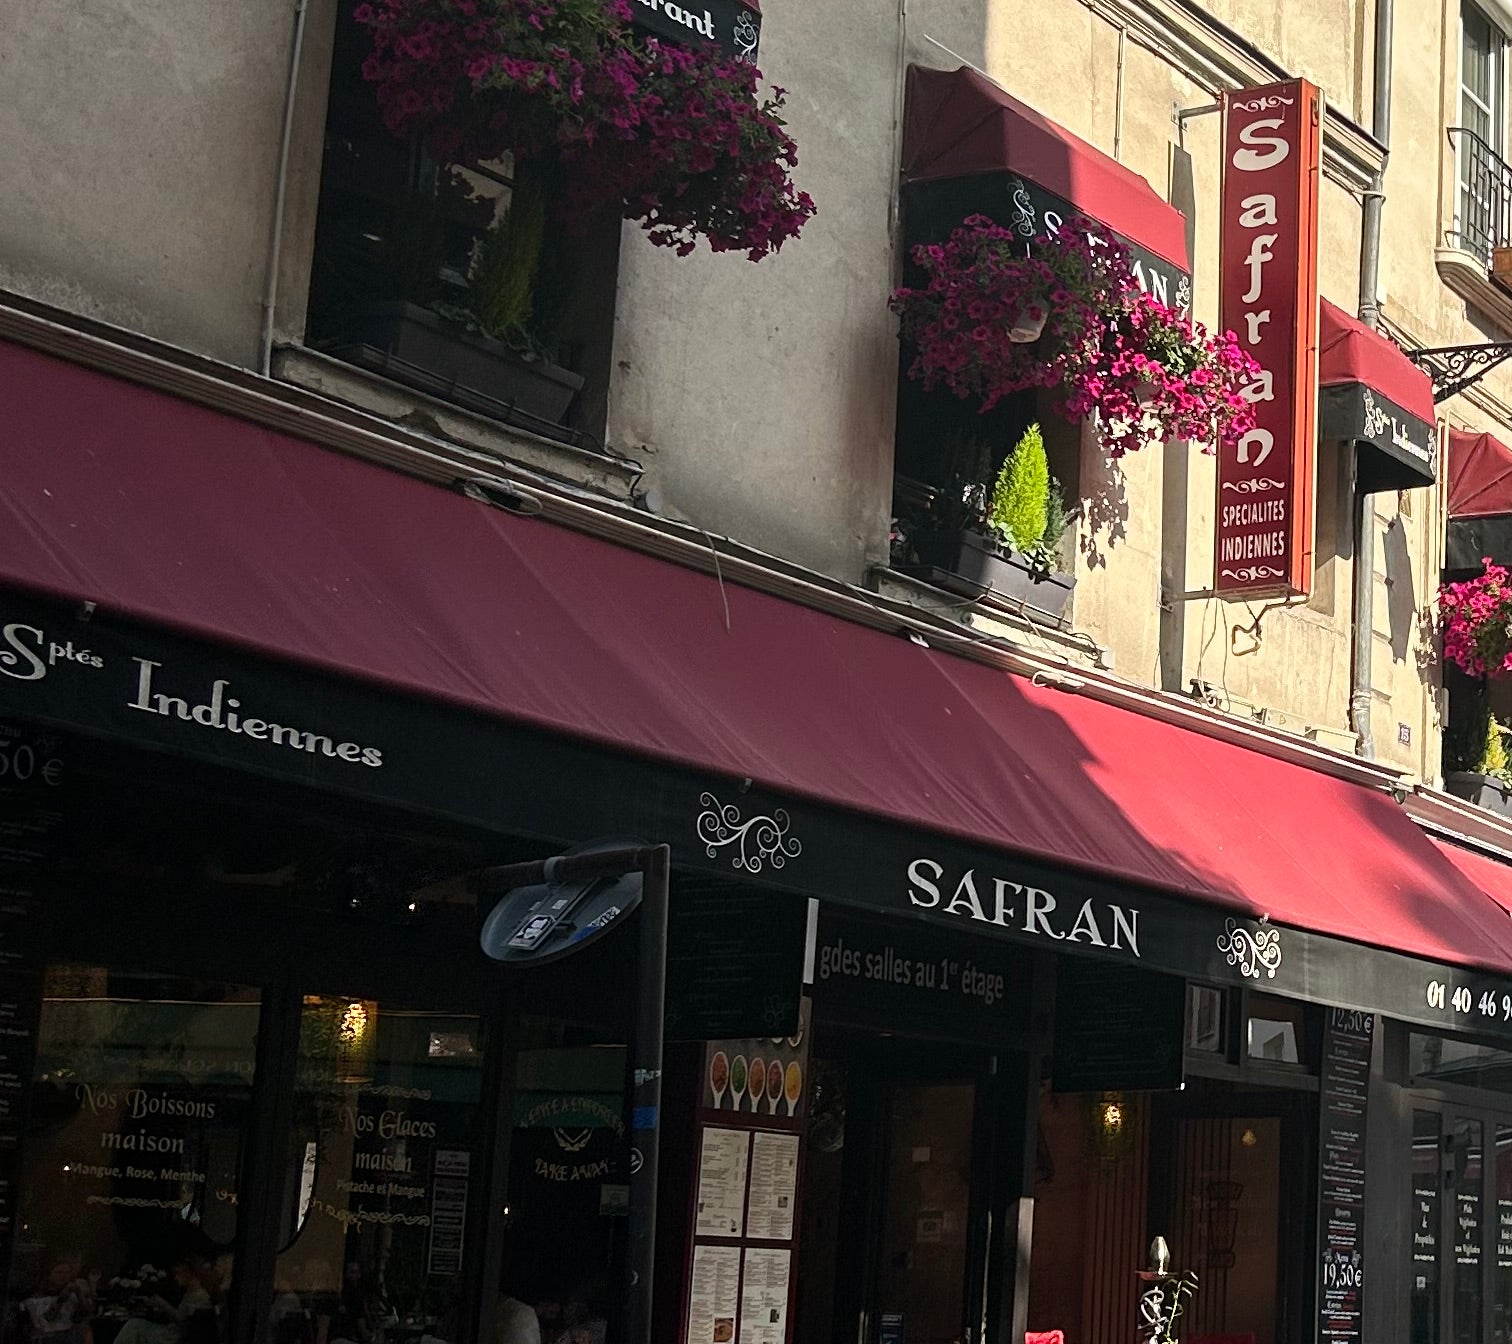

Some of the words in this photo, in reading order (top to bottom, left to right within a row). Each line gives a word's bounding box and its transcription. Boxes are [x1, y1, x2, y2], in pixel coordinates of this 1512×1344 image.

[1232, 118, 1290, 467] Safran
[1222, 498, 1286, 529] SPECIALITES
[1220, 529, 1286, 562] INDIENNES
[128, 656, 383, 768] Indiennes
[906, 858, 1142, 958] SAFRAN
[820, 938, 861, 980] gdes
[864, 946, 912, 985] salles
[915, 961, 936, 988] au
[961, 960, 1004, 1005] étage
[1427, 979, 1445, 1010] 01
[1450, 987, 1472, 1014] 40
[1478, 991, 1497, 1018] 46
[75, 1083, 117, 1116] Nos
[125, 1088, 216, 1119] Boissons
[100, 1128, 185, 1155] maison
[379, 1110, 437, 1140] Glaces
[126, 1165, 158, 1182] Rose,
[160, 1167, 206, 1183] Menthe
